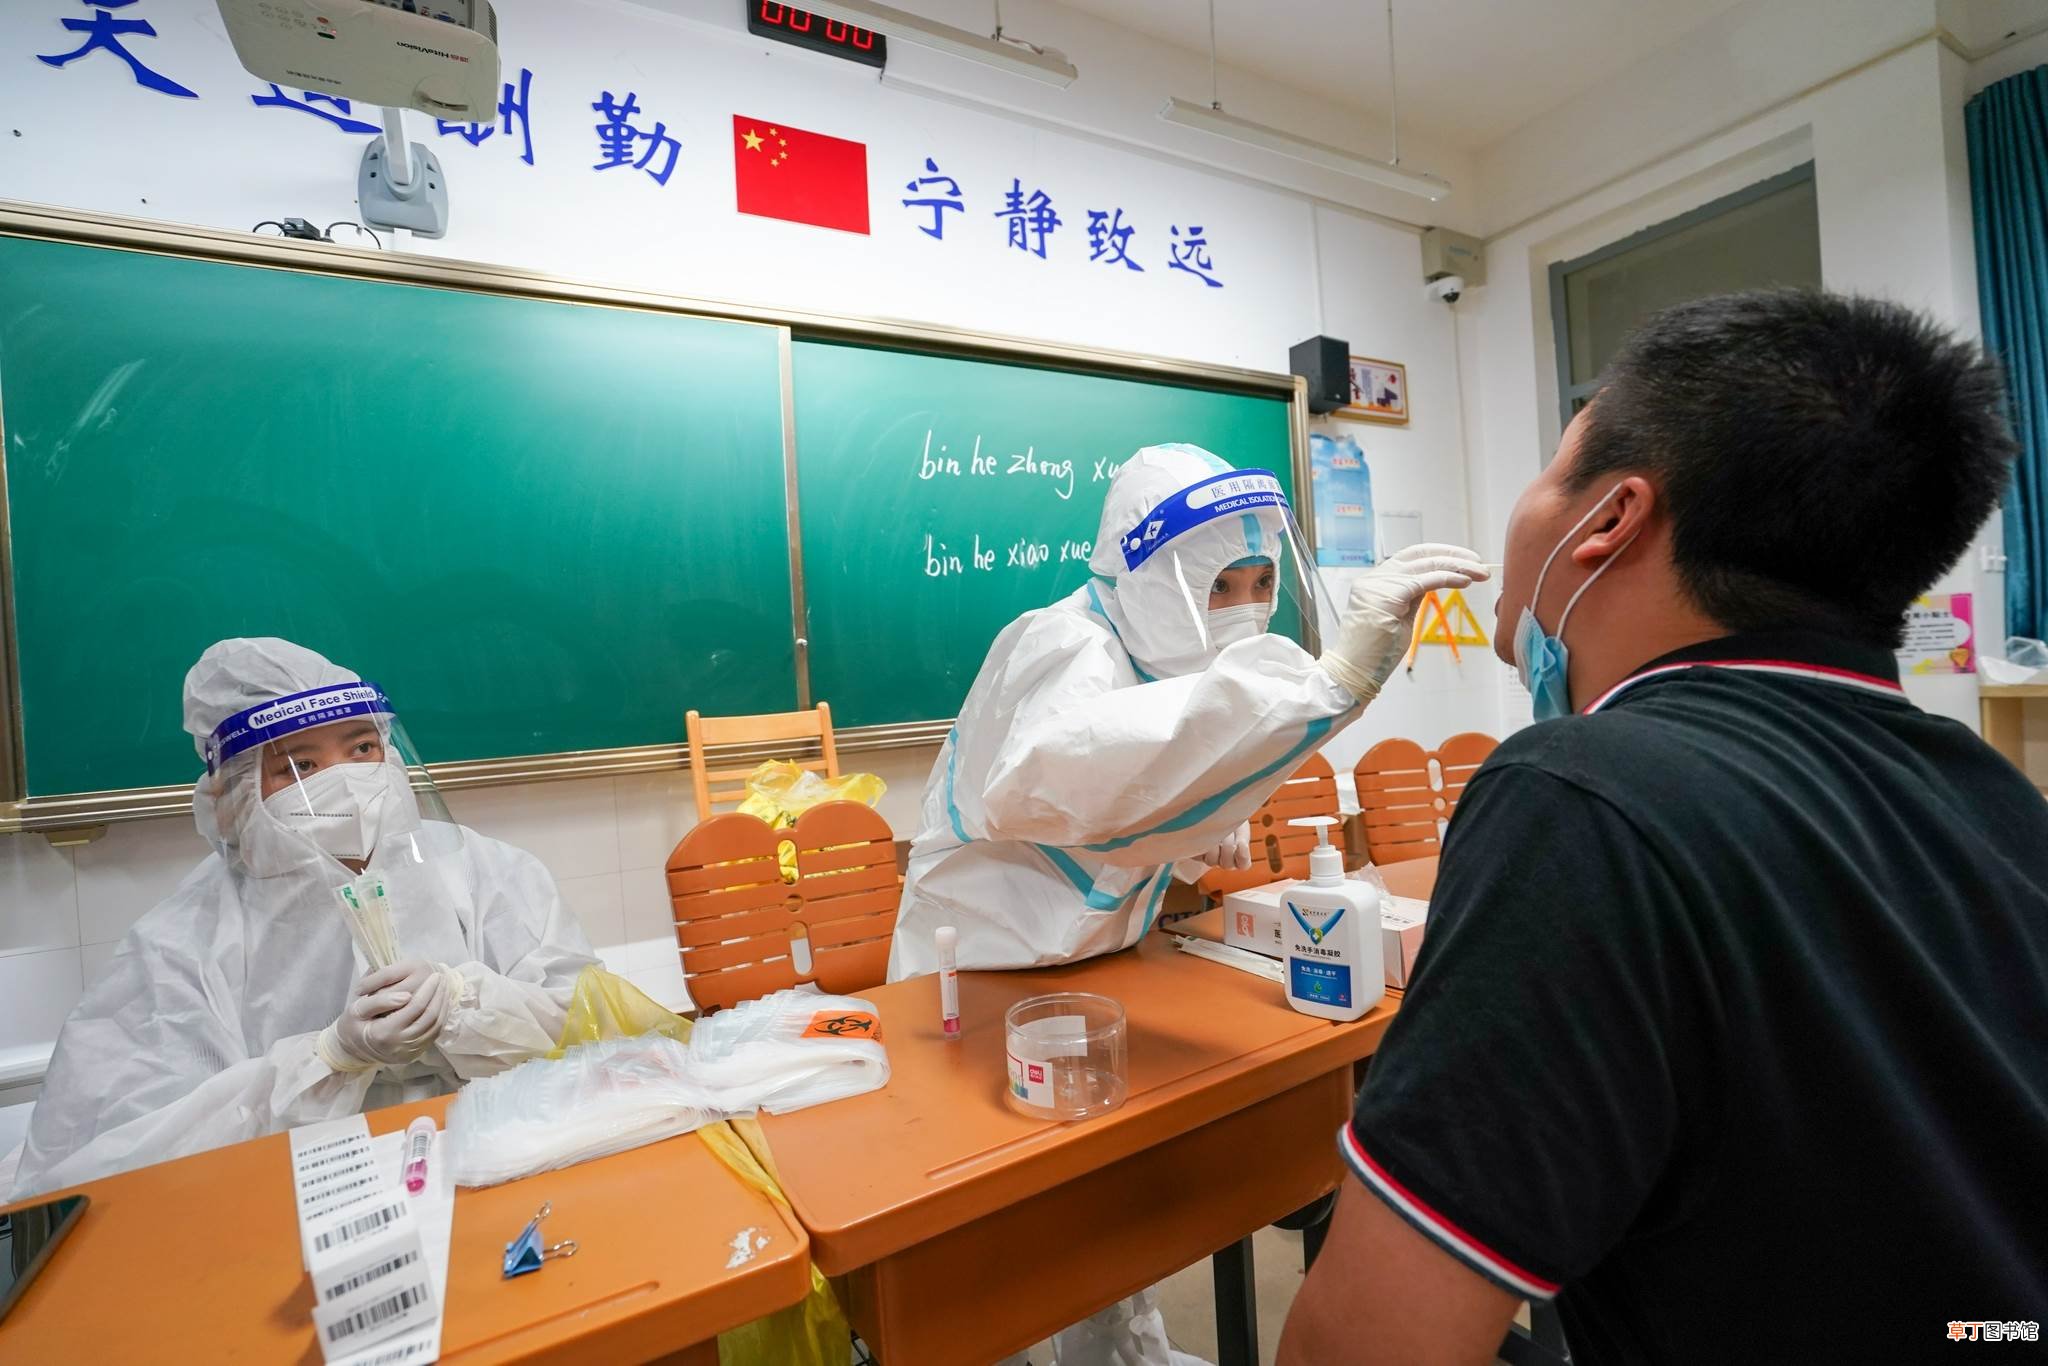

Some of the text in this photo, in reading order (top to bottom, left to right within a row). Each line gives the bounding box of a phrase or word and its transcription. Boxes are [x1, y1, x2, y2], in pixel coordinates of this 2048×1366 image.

[902, 158, 1224, 288] 宁静致远
[919, 430, 961, 480] bin
[971, 434, 998, 476] he
[1007, 446, 1074, 500] zhong
[1214, 497, 1249, 513] MEDICAL
[925, 533, 1092, 577] bin he xiao xue
[253, 701, 307, 726] Medical
[309, 695, 340, 709] Face
